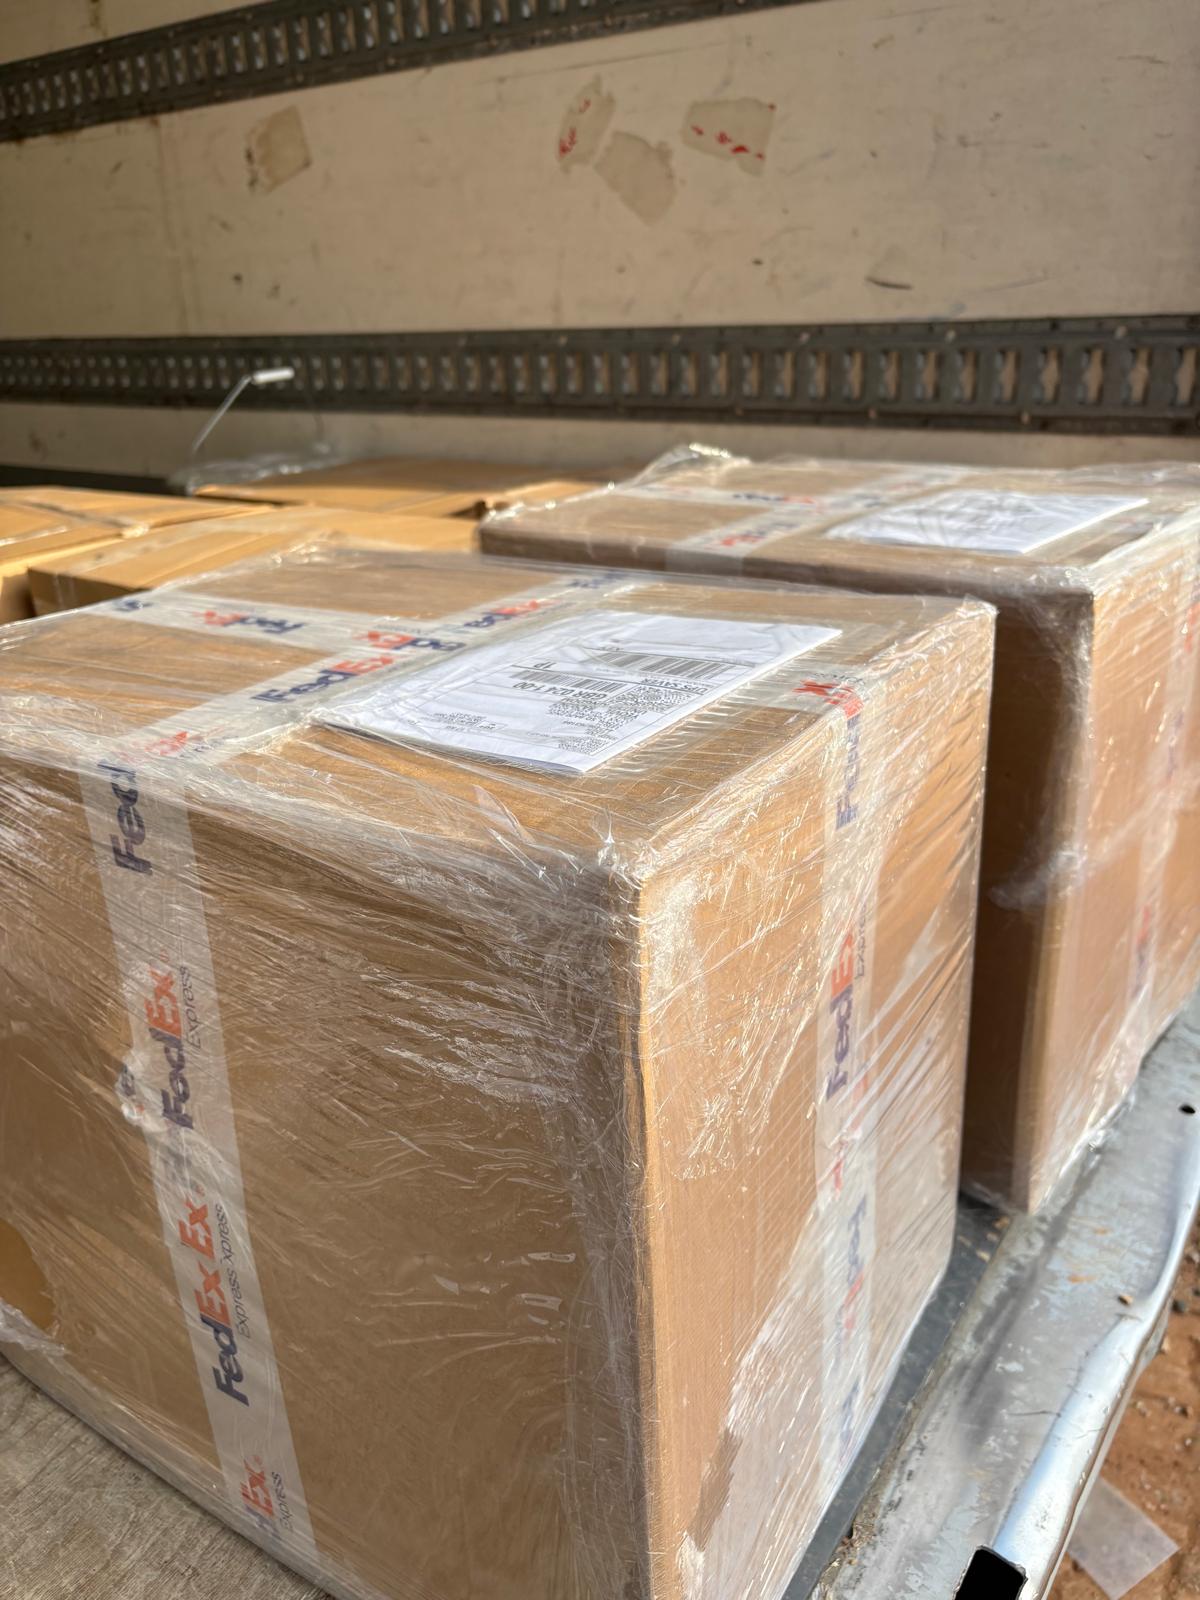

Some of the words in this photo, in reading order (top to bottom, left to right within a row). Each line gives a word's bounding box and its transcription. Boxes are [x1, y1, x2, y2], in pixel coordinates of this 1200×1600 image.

[252, 655, 393, 702] FedEx
[548, 686, 576, 696] 024
[573, 690, 608, 700] GBR
[179, 965, 201, 1051] Express
[144, 966, 194, 1129] FedEx
[215, 1203, 236, 1265] xpress
[194, 1260, 250, 1407] FedEx
[227, 1267, 251, 1339] Express
